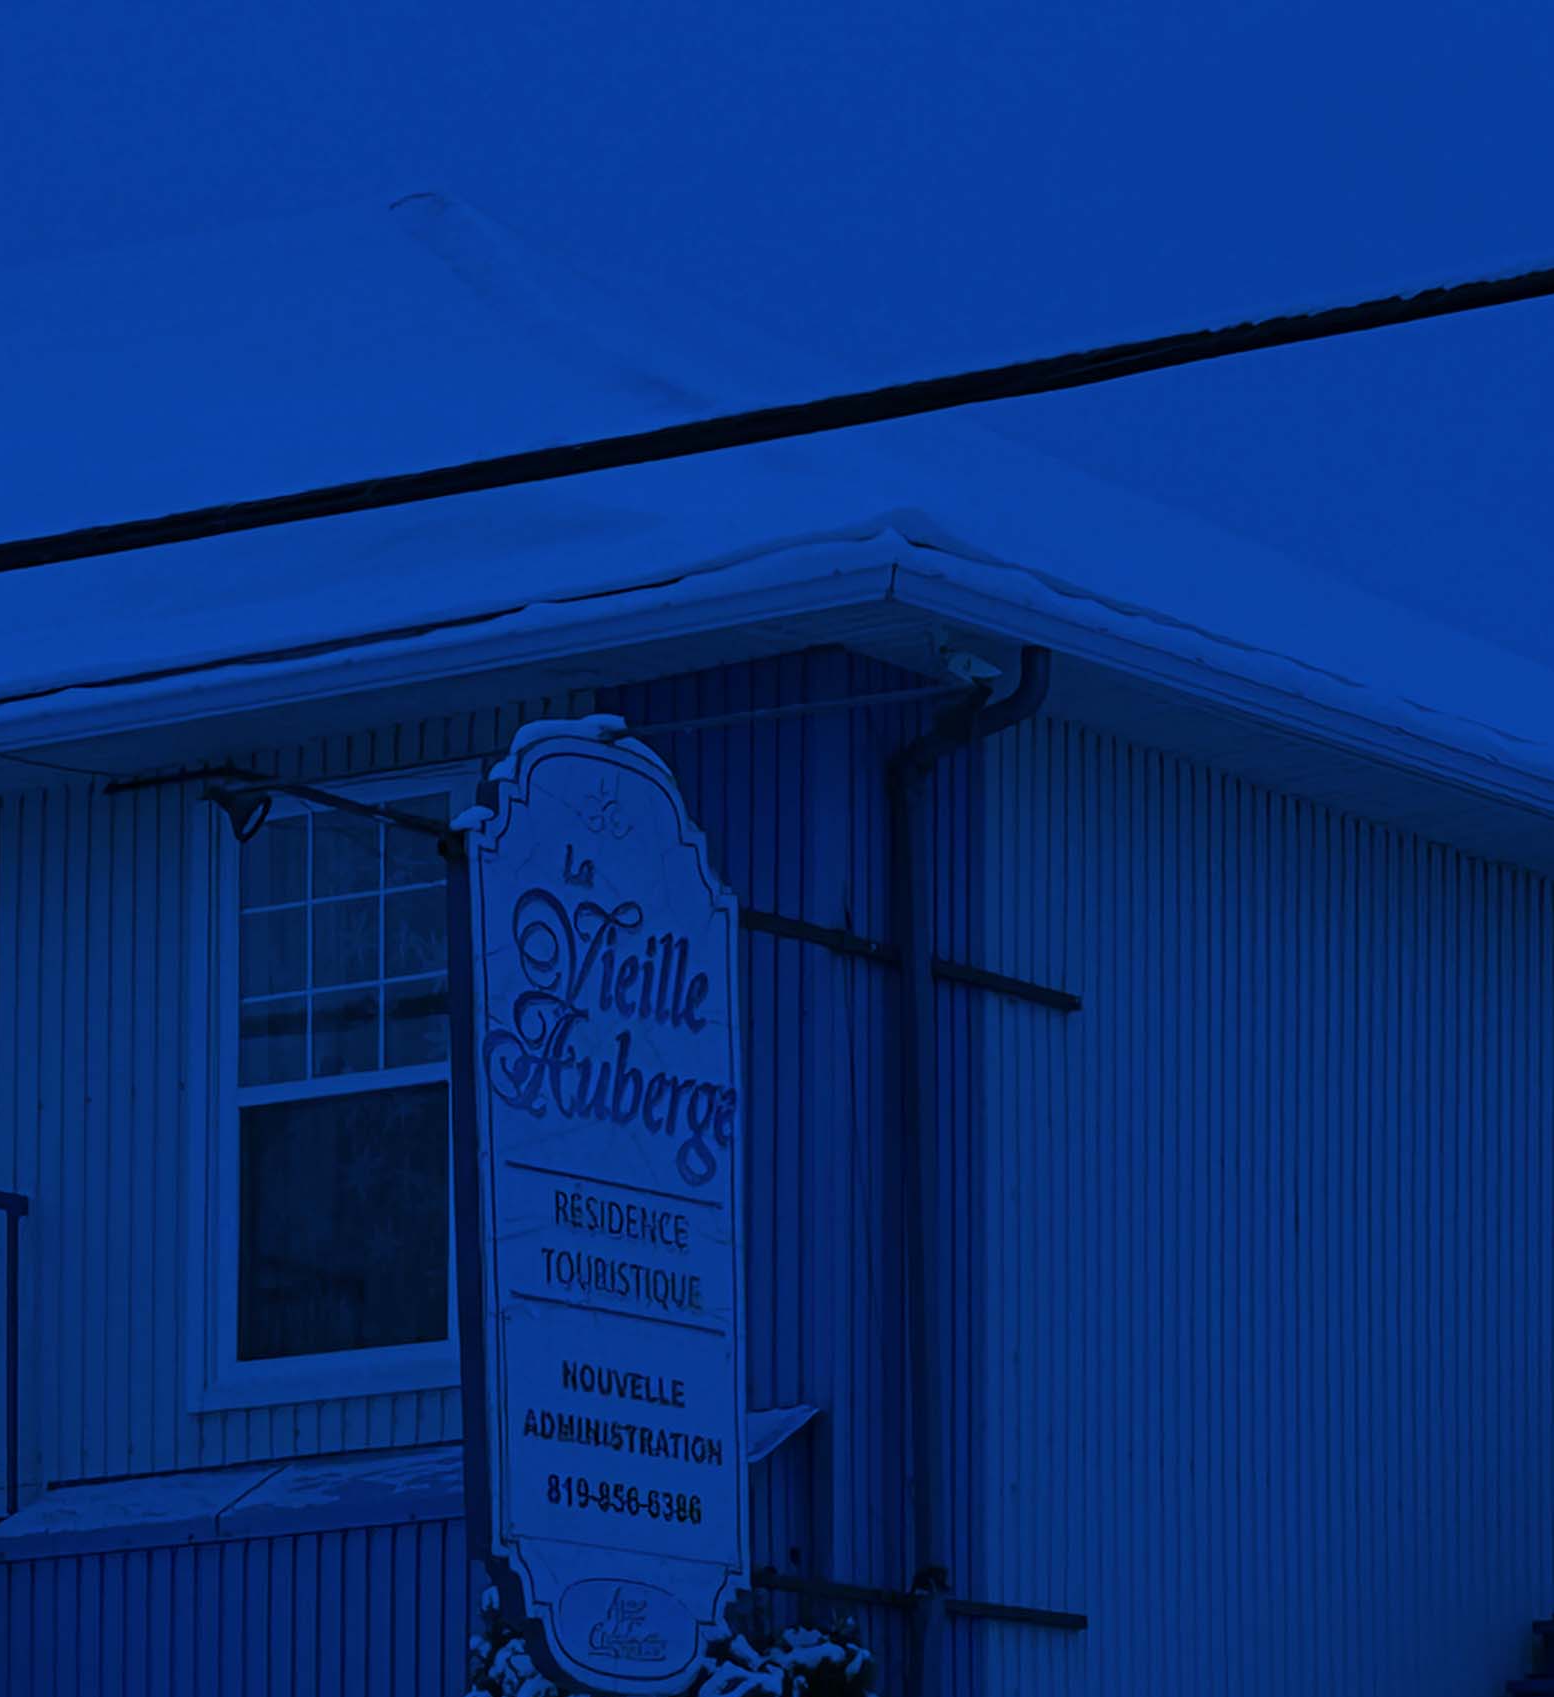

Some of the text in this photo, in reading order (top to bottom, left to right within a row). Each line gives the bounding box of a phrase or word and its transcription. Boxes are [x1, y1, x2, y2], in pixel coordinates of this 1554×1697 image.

[563, 843, 595, 887] La
[513, 887, 710, 1033] Vieille
[483, 992, 737, 1185] Auberge
[542, 1247, 703, 1311] TOURISTIQUE
[562, 1359, 686, 1409] NOUVELLE
[523, 1408, 724, 1466] ADMINISTRATION
[547, 1474, 703, 1525] 819-856-6386
